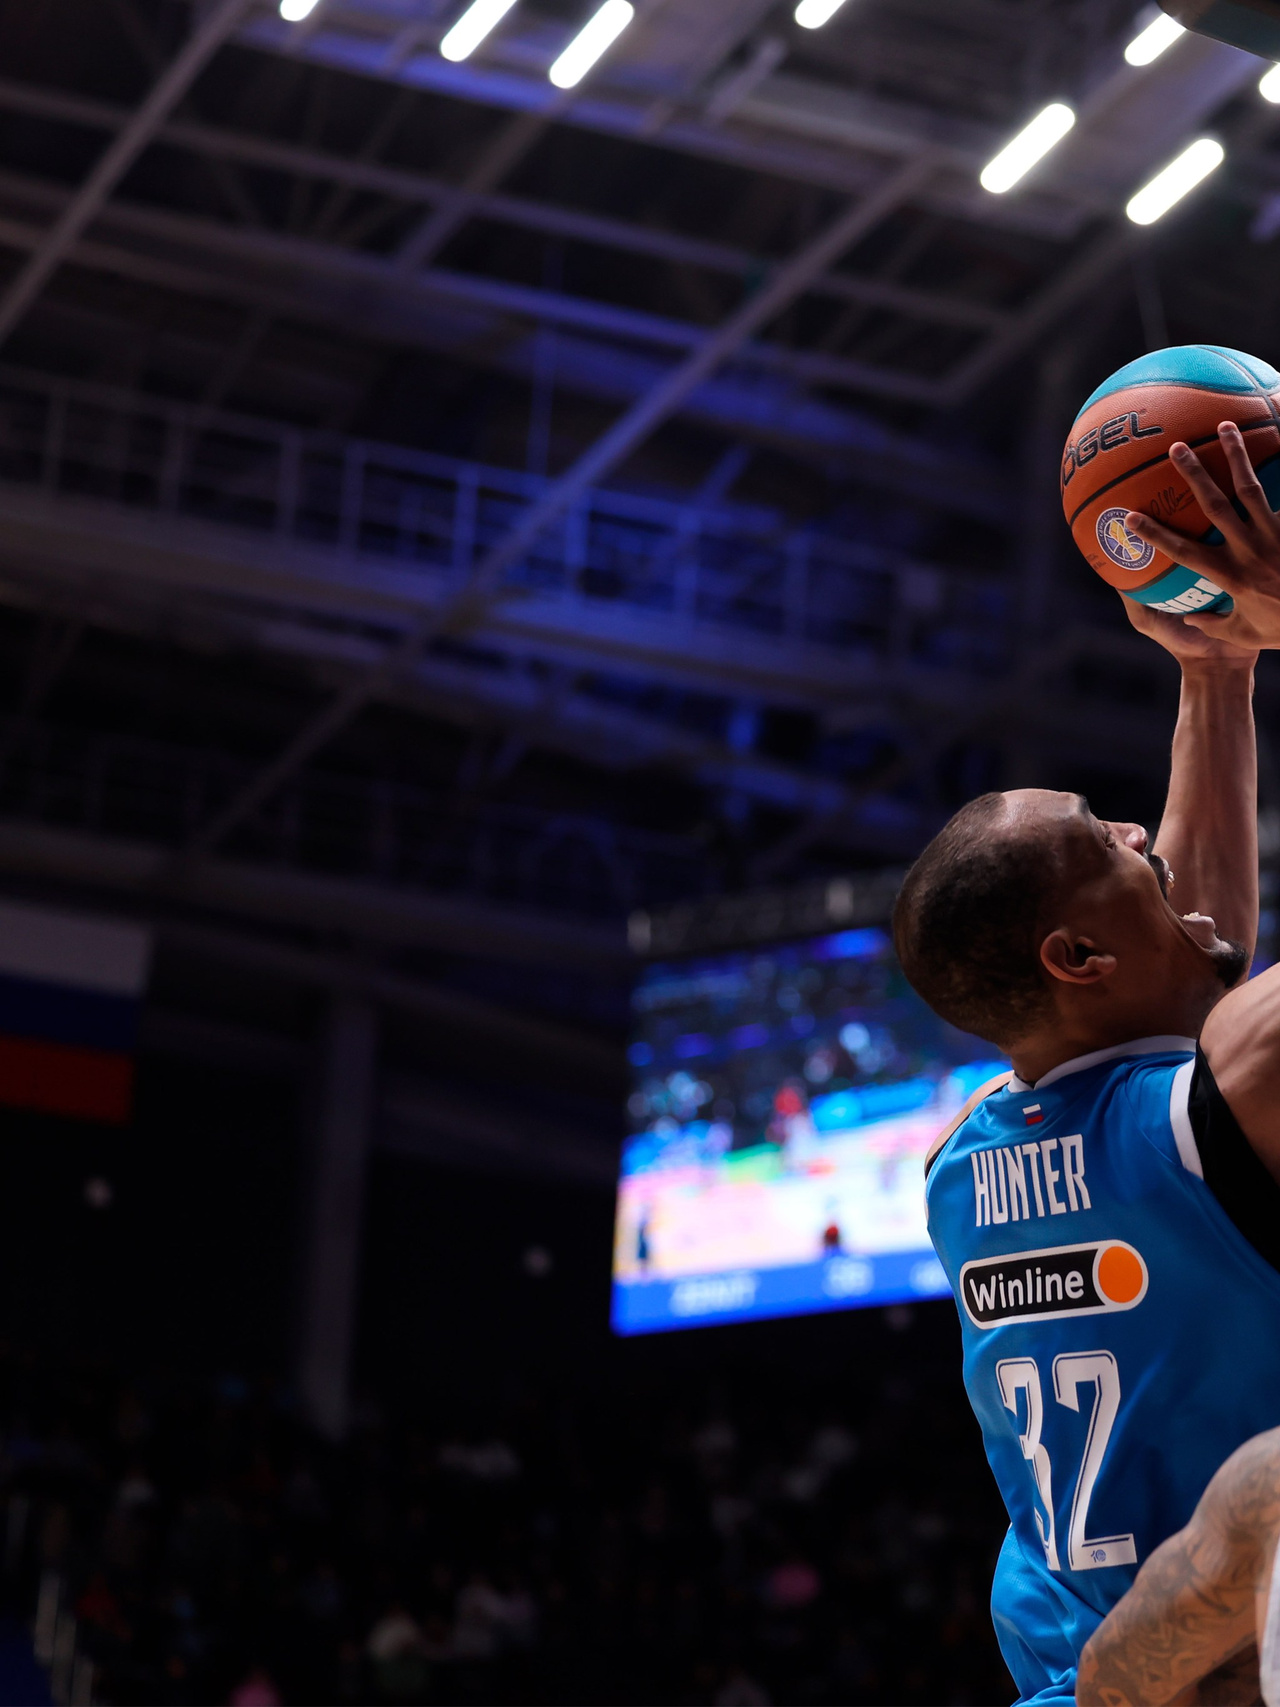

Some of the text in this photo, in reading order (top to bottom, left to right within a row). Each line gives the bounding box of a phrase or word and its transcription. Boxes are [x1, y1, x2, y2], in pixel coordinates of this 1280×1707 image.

[970, 1133, 1092, 1228] HUNTER
[969, 1266, 1085, 1313] Winline
[995, 1349, 1138, 1572] 32
